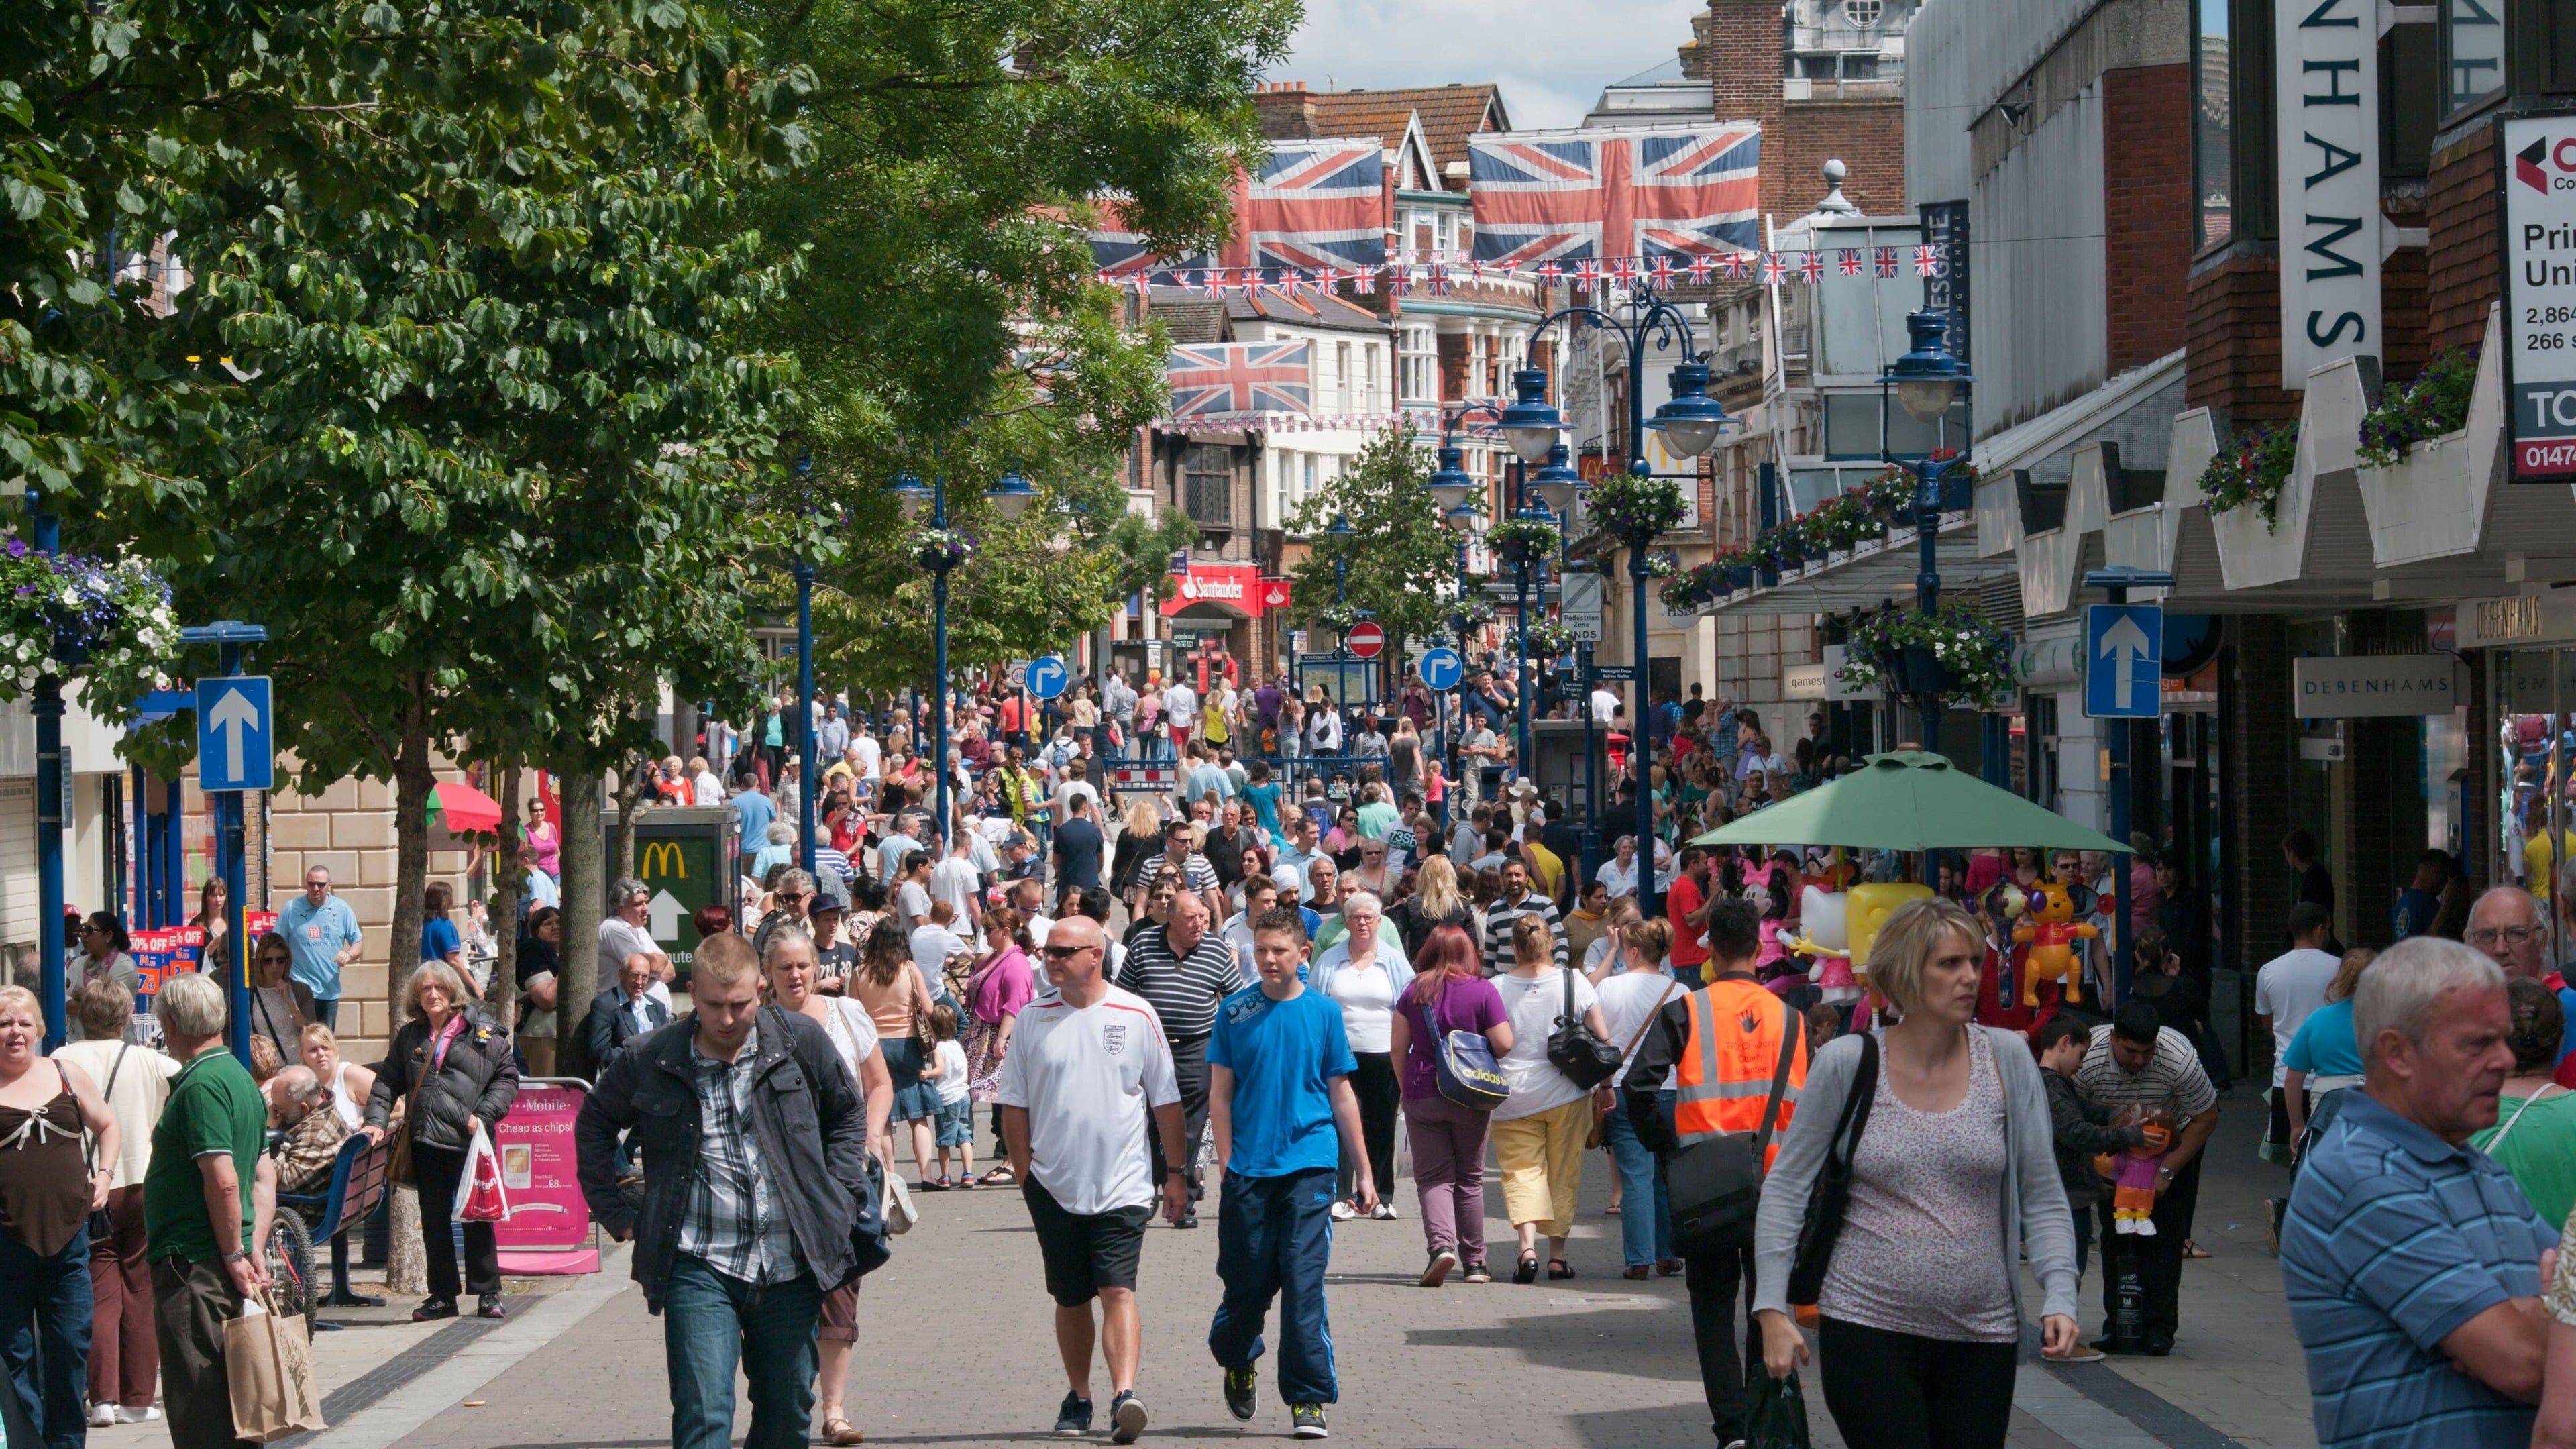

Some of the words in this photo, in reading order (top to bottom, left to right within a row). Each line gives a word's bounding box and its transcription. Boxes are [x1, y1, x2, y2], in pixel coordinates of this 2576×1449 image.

[2524, 223, 2576, 250] Pri
[1954, 214, 1962, 278] CENTRE
[2527, 333, 2565, 350] 266
[2526, 445, 2576, 468] 0147
[1196, 575, 1244, 598] Santander
[1667, 606, 1695, 616] HSB
[2477, 595, 2542, 639] DEBENHAMS
[1574, 630, 1597, 639] NDS
[2305, 678, 2447, 695] DEBENHAMS
[150, 937, 168, 951] OFF
[184, 930, 201, 943] OFF
[669, 950, 693, 963] ute
[1462, 1068, 1501, 1085] adidas
[526, 1099, 566, 1111] Mobile
[498, 1123, 530, 1135] Cheap
[531, 1124, 543, 1132] as
[544, 1122, 573, 1134] chips!
[549, 1179, 559, 1189] £8
